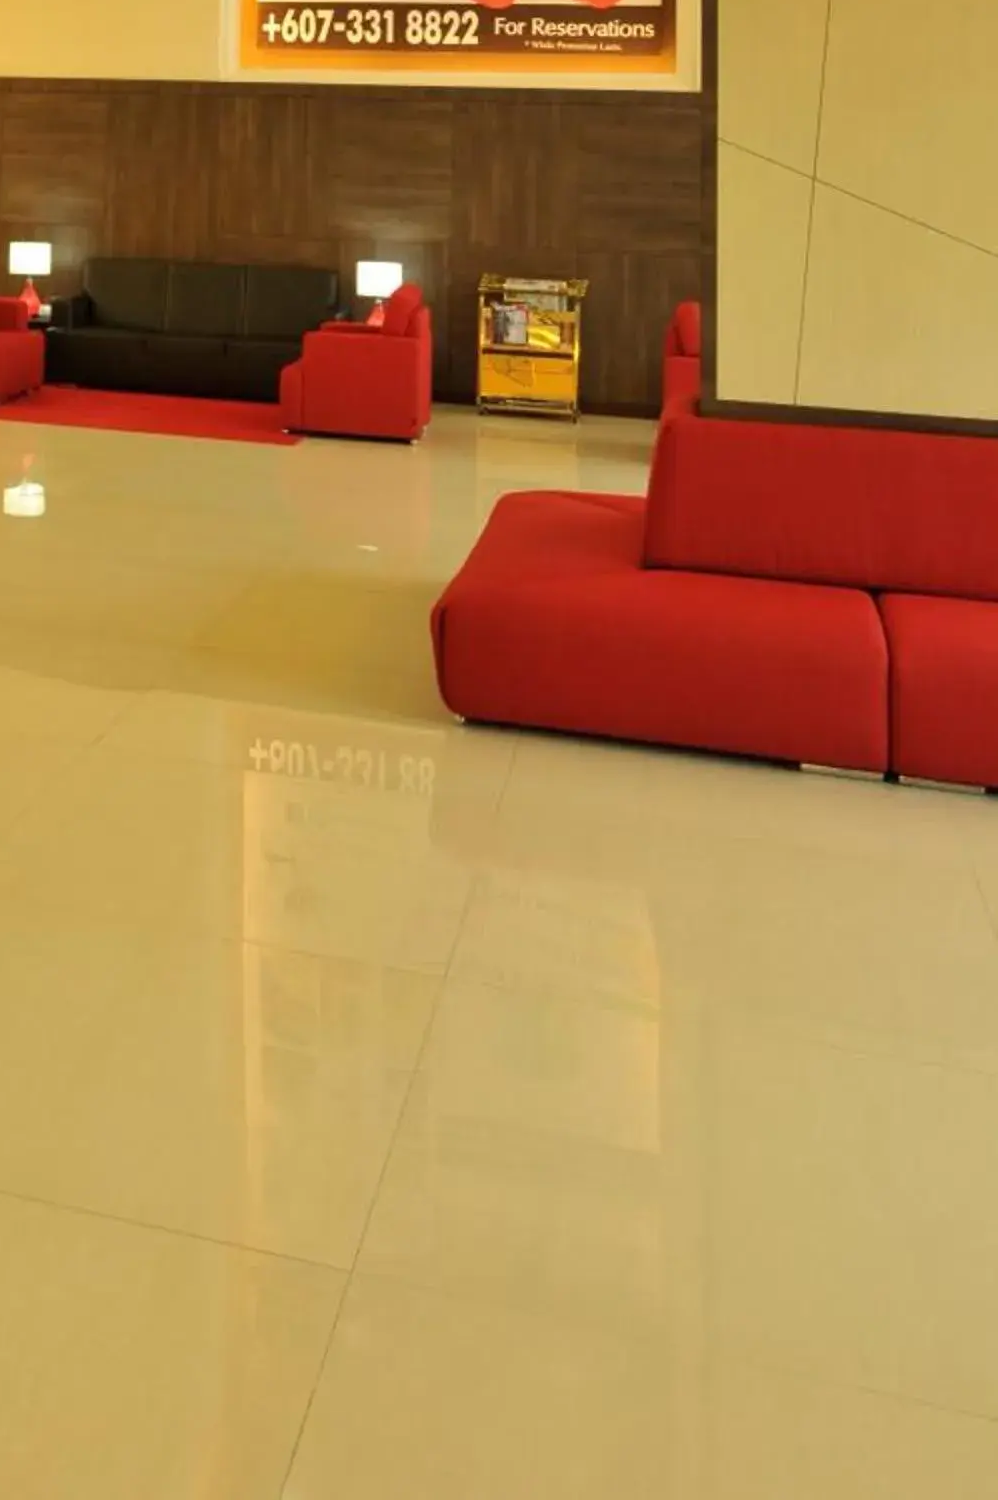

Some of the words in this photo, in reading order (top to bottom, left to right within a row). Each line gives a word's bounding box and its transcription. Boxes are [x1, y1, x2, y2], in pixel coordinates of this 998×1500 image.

[262, 8, 395, 44] +607-331
[405, 9, 479, 45] 8822
[494, 17, 527, 37] For
[531, 17, 655, 38] Reservations
